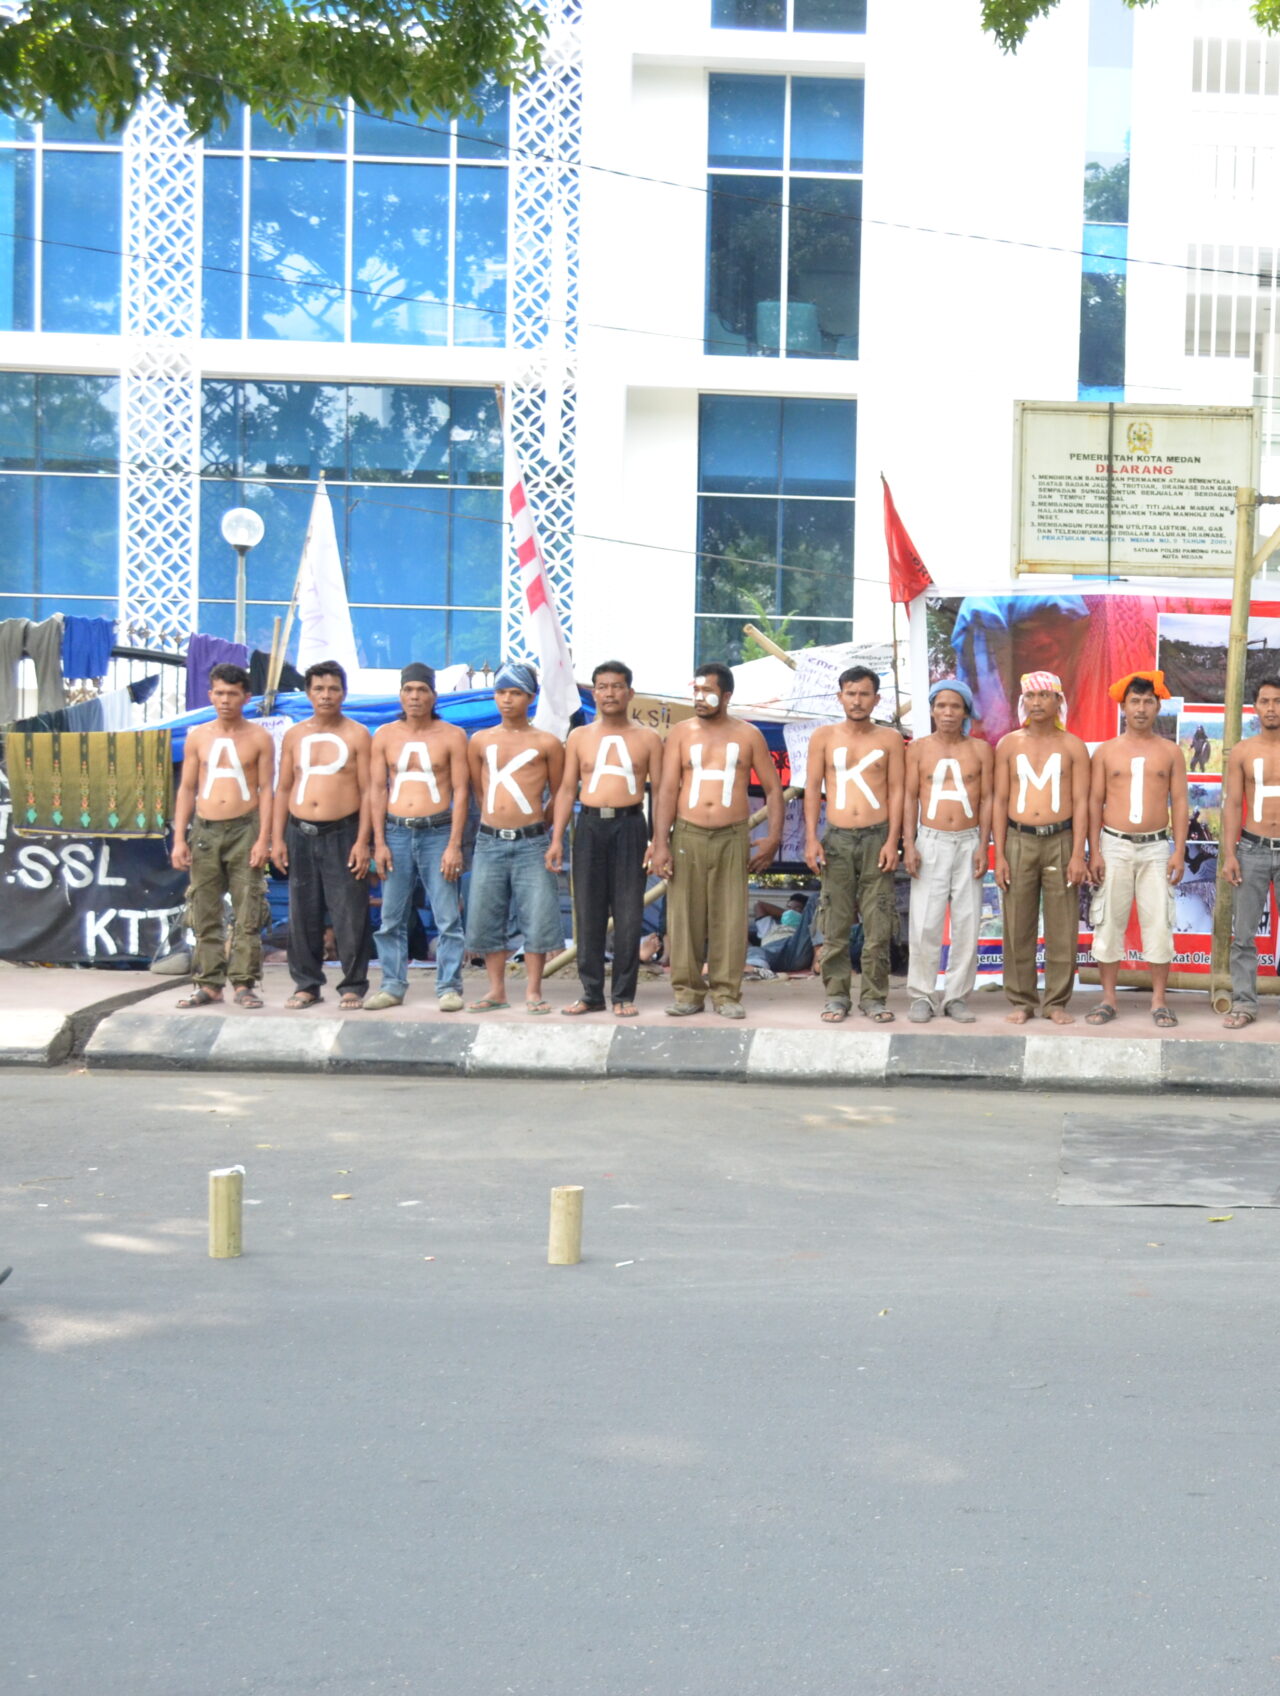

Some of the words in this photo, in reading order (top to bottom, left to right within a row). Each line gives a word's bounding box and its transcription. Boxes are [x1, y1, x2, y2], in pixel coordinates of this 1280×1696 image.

[1069, 453, 1134, 463] PEMERITAH
[1136, 455, 1163, 463] KOTA
[1166, 456, 1201, 464] MEDAN
